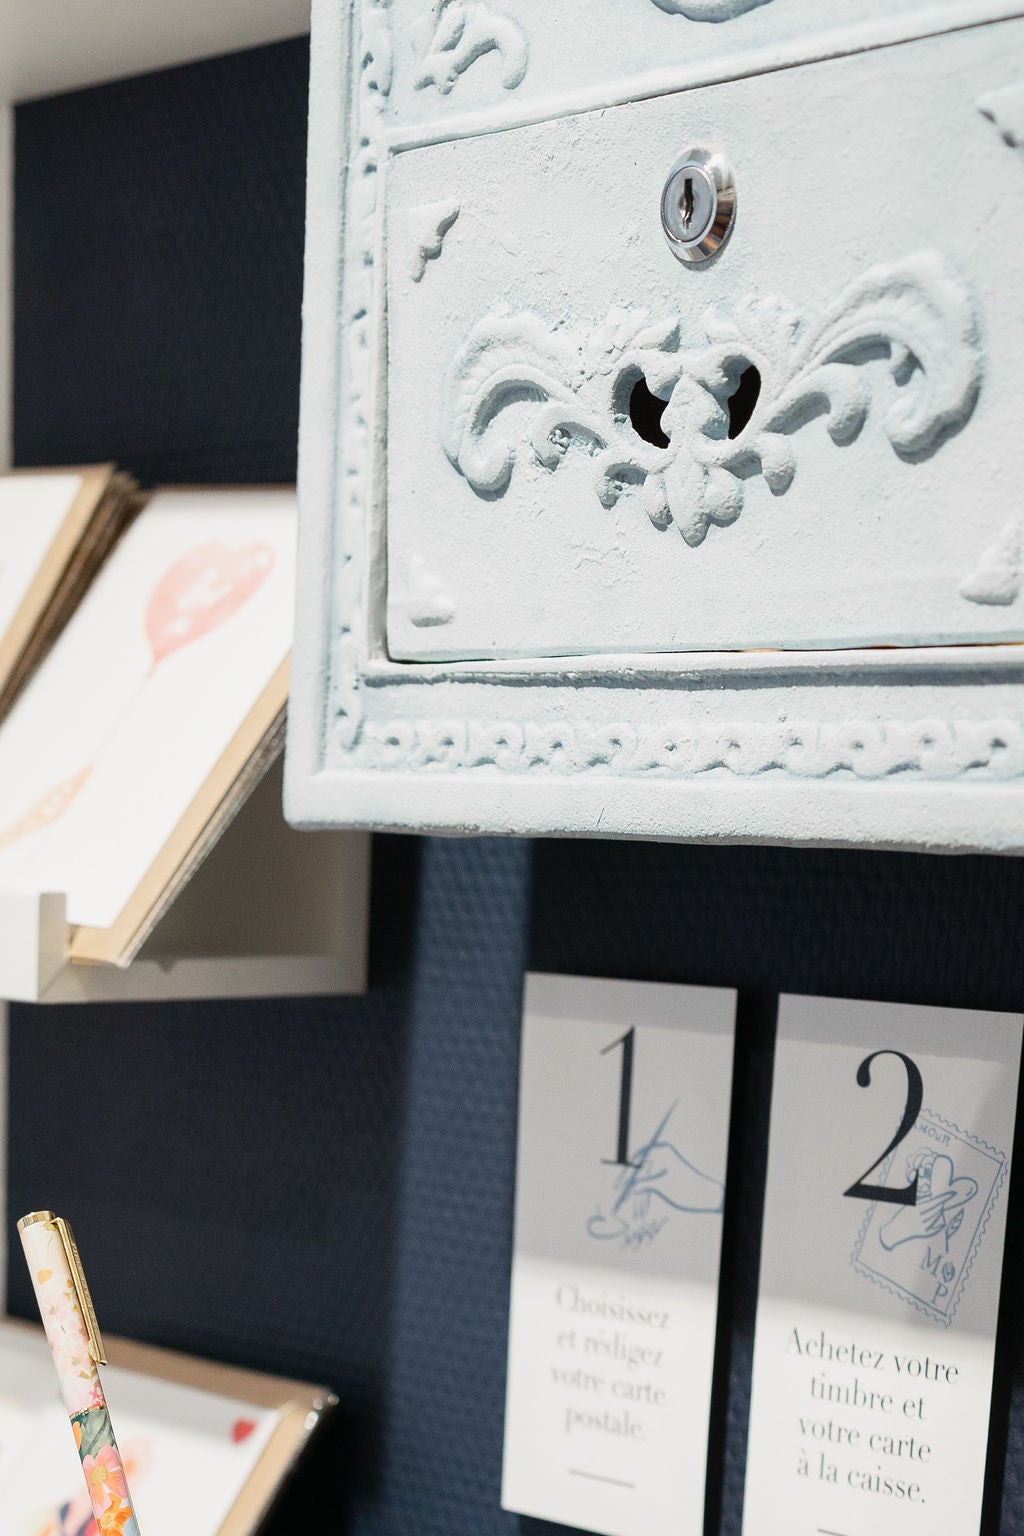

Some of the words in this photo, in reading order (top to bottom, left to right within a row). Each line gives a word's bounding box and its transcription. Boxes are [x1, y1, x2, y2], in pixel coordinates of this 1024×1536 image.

[600, 1025, 640, 1168] 1
[843, 1050, 924, 1206] 2
[555, 1283, 670, 1328] Choisissez
[556, 1330, 576, 1350] et
[584, 1329, 664, 1372] rédigez
[786, 1327, 885, 1371] Achetez
[894, 1356, 959, 1384] votre
[550, 1364, 605, 1391] votre
[611, 1381, 666, 1404] carte
[811, 1372, 894, 1412] timbre
[903, 1397, 926, 1420] et
[564, 1408, 647, 1441] postale.
[799, 1418, 861, 1447] votre
[869, 1433, 931, 1463] carte
[797, 1448, 809, 1477] à
[820, 1453, 838, 1484] la
[847, 1465, 926, 1503] caisse.
